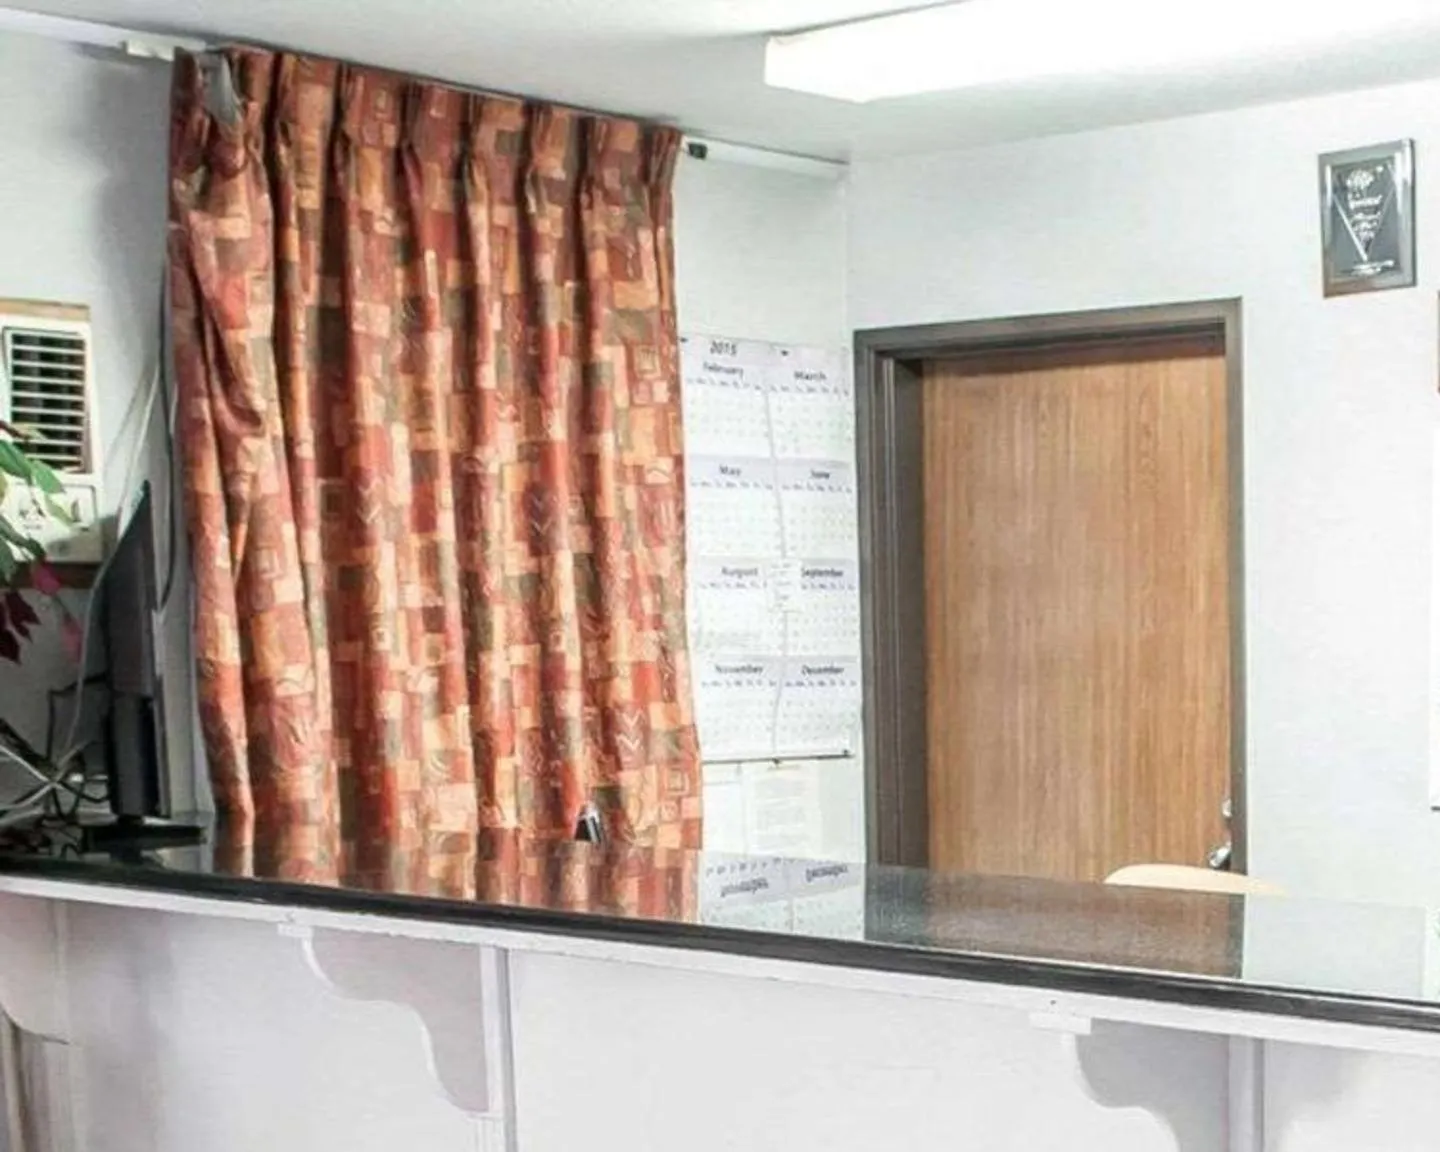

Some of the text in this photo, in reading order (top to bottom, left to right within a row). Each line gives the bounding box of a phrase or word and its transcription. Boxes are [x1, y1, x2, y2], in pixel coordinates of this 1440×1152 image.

[703, 361, 744, 379] February
[794, 369, 827, 381] March
[719, 464, 742, 477] May
[721, 565, 758, 579] August
[801, 567, 844, 579] September
[714, 664, 764, 675] November
[801, 664, 845, 676] December
